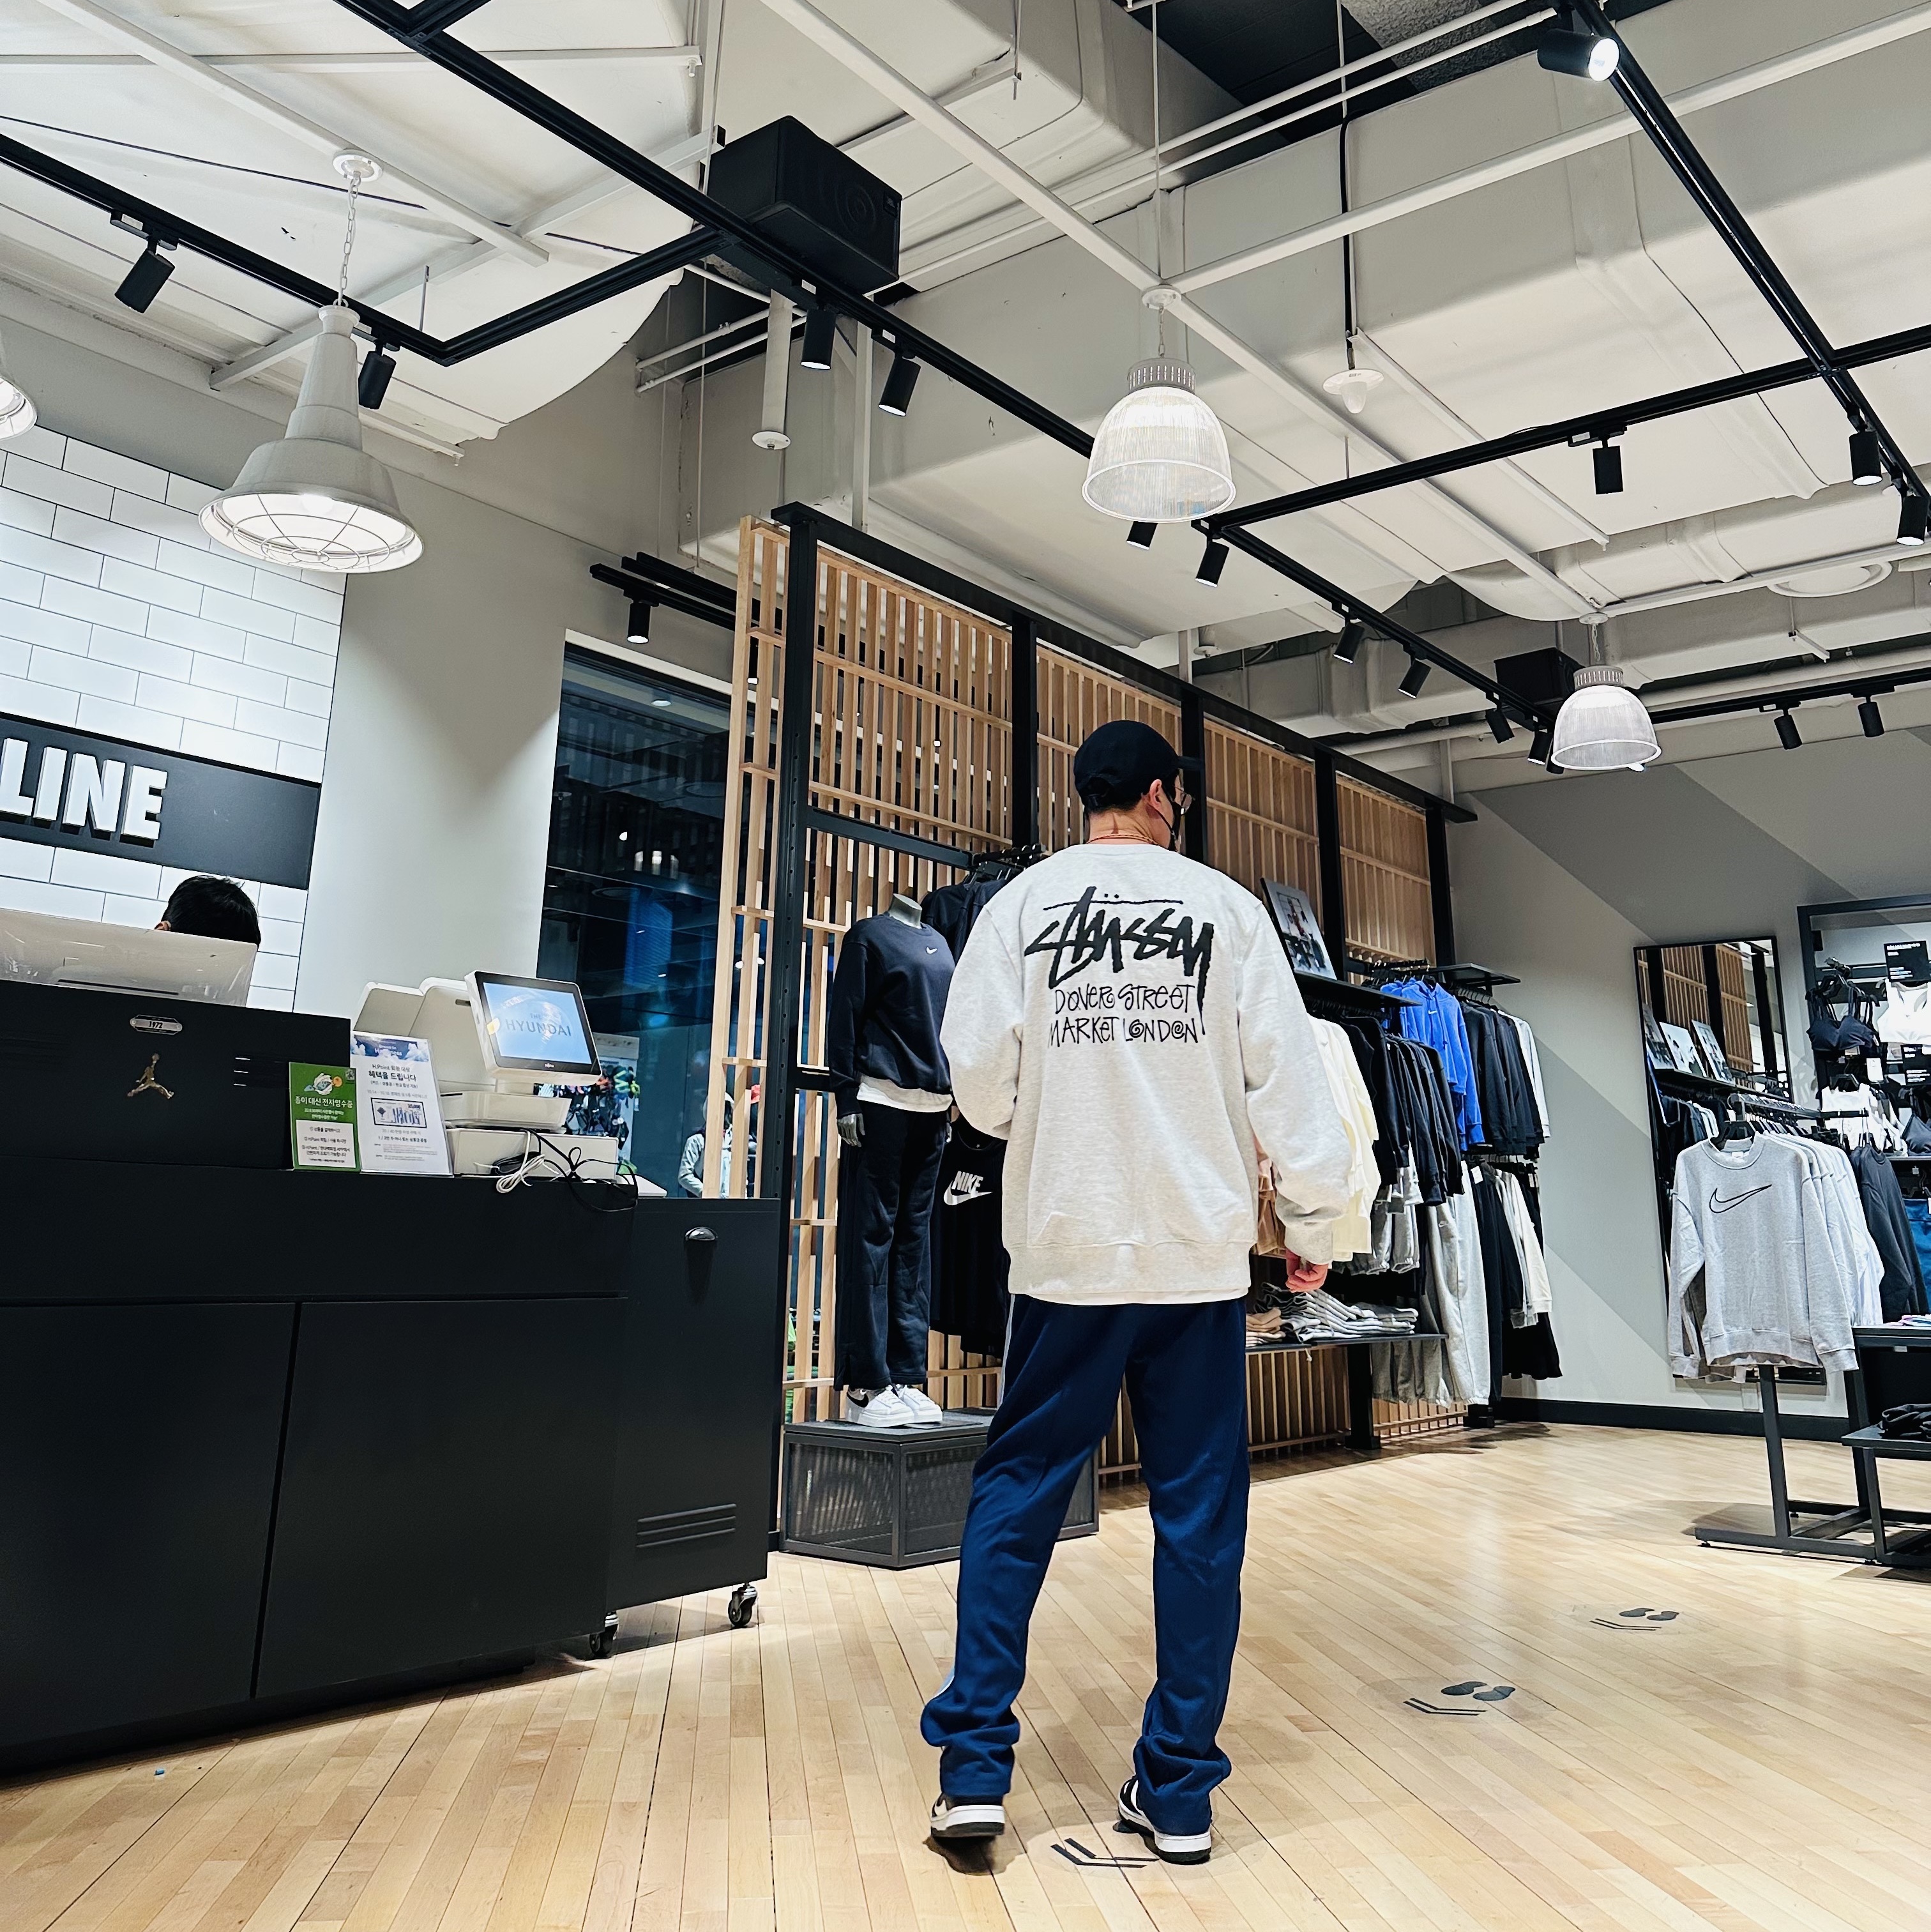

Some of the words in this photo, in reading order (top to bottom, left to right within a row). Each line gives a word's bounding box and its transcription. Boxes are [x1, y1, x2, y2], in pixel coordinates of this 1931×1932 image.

[0, 738, 168, 840] LINE
[149, 1021, 163, 1029] 1972
[505, 1019, 572, 1036] HYUNDAI
[390, 1072, 416, 1081] 드립니다
[294, 1096, 307, 1104] 종이
[308, 1097, 321, 1106] 대신
[322, 1098, 353, 1108] 전자영수증
[951, 1171, 983, 1194] NIKE
